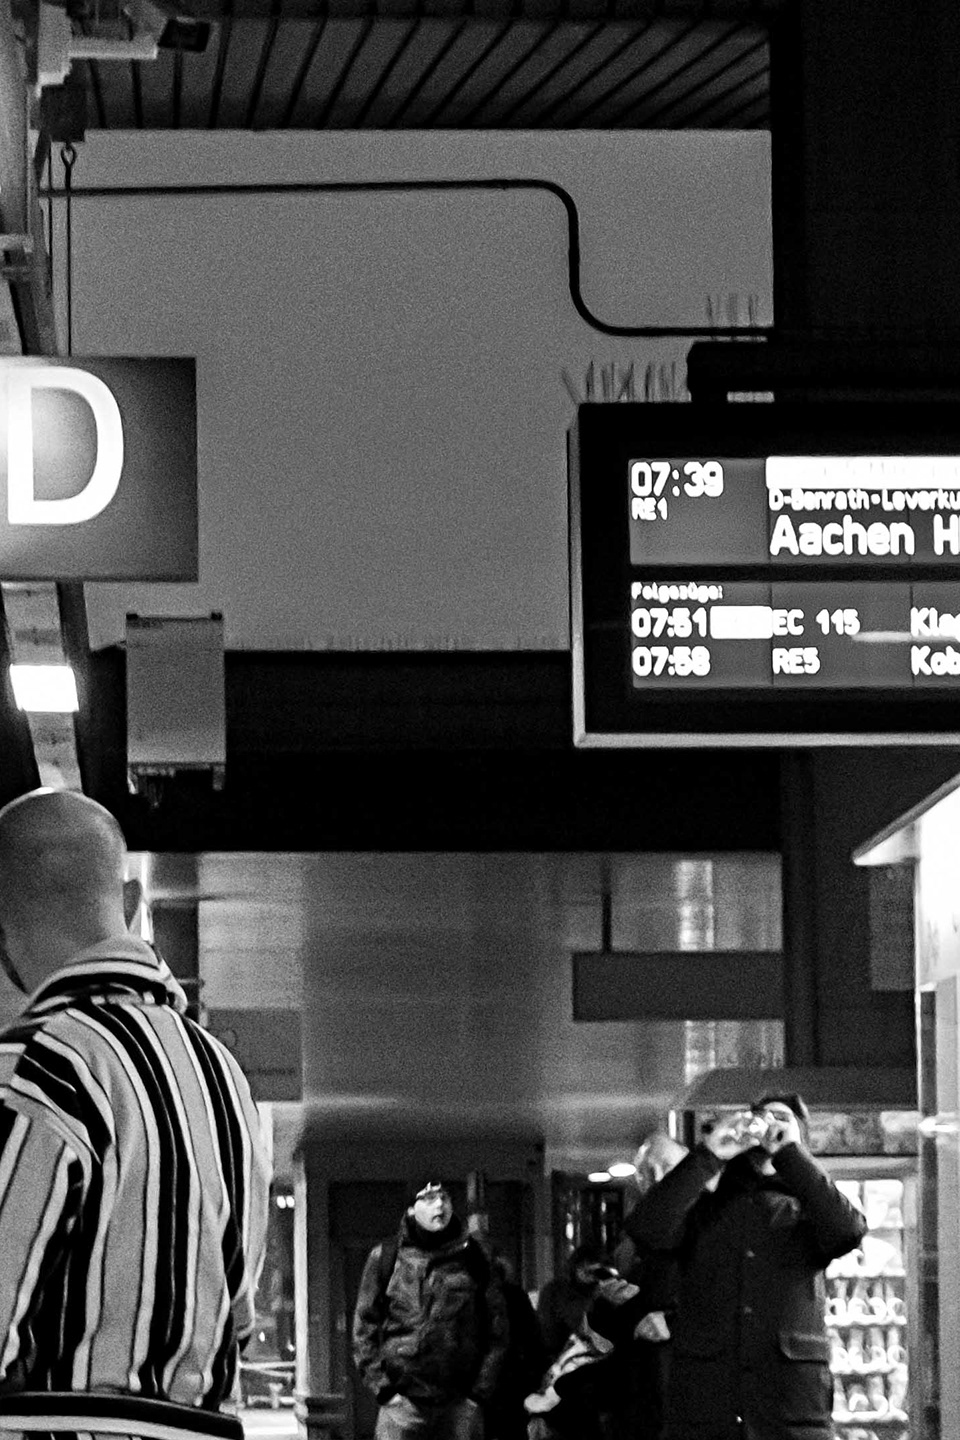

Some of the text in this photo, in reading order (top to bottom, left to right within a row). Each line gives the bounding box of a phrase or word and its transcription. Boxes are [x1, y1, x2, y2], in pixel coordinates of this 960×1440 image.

[7, 365, 125, 525] D
[629, 460, 724, 498] 07:39
[629, 496, 668, 521] RE1
[769, 513, 960, 556] Aachen H
[630, 606, 708, 638] 07:51
[771, 608, 805, 636] EC
[815, 608, 861, 636] 115
[771, 646, 821, 676] RE5
